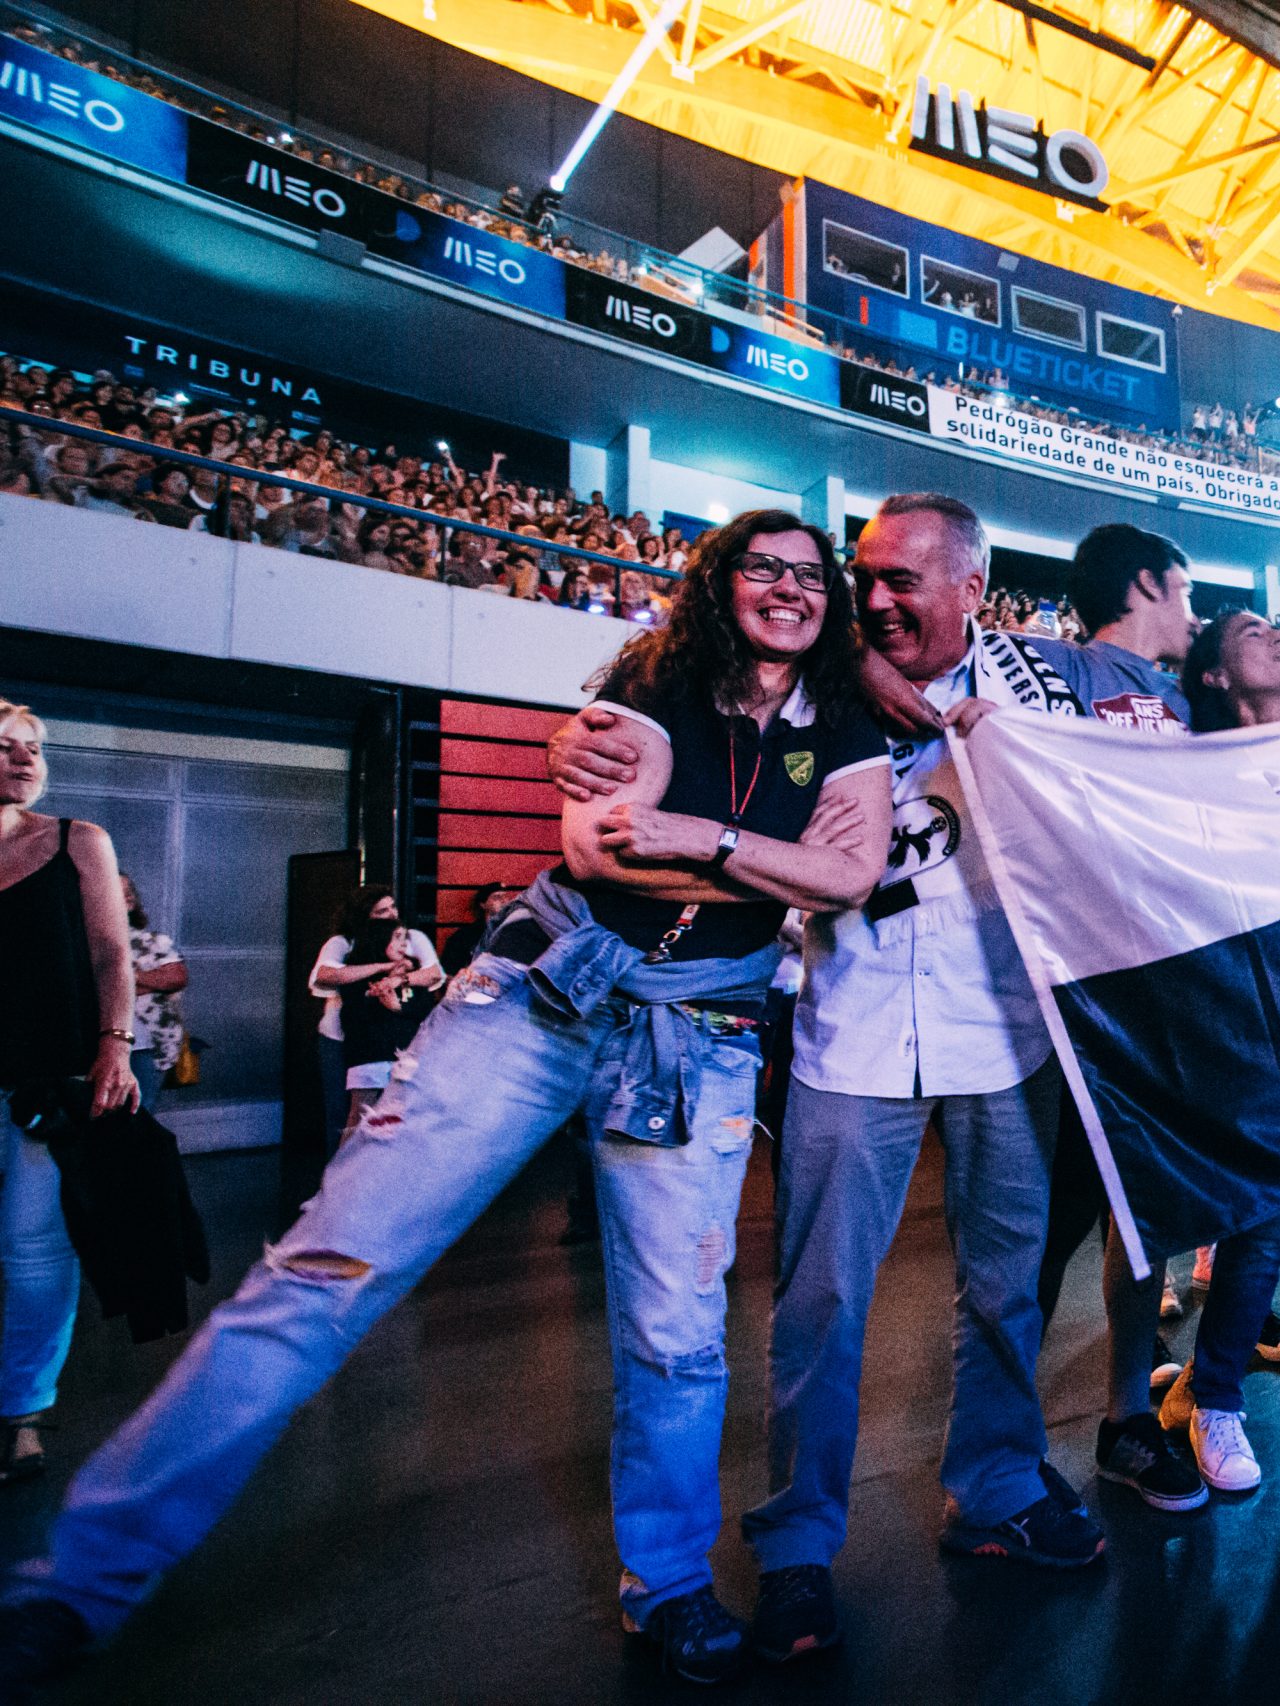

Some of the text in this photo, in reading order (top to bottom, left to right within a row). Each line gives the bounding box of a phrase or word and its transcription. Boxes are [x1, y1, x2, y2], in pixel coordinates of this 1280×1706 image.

[0, 62, 124, 132] MEO
[911, 75, 1109, 198] MEO
[246, 160, 346, 217] MEO
[444, 236, 526, 284] MEO
[605, 295, 677, 337] MEO
[125, 335, 322, 405] TRIBUNA
[746, 344, 809, 381] MEO
[947, 326, 1140, 400] BLUETICKET
[870, 383, 926, 416] MEO
[947, 419, 1086, 467] solidariedade
[1093, 458, 1115, 474] de
[1122, 465, 1150, 482] um
[1157, 473, 1199, 494] país.
[955, 396, 1279, 491] Pedrógão Grande não esquecerá a
